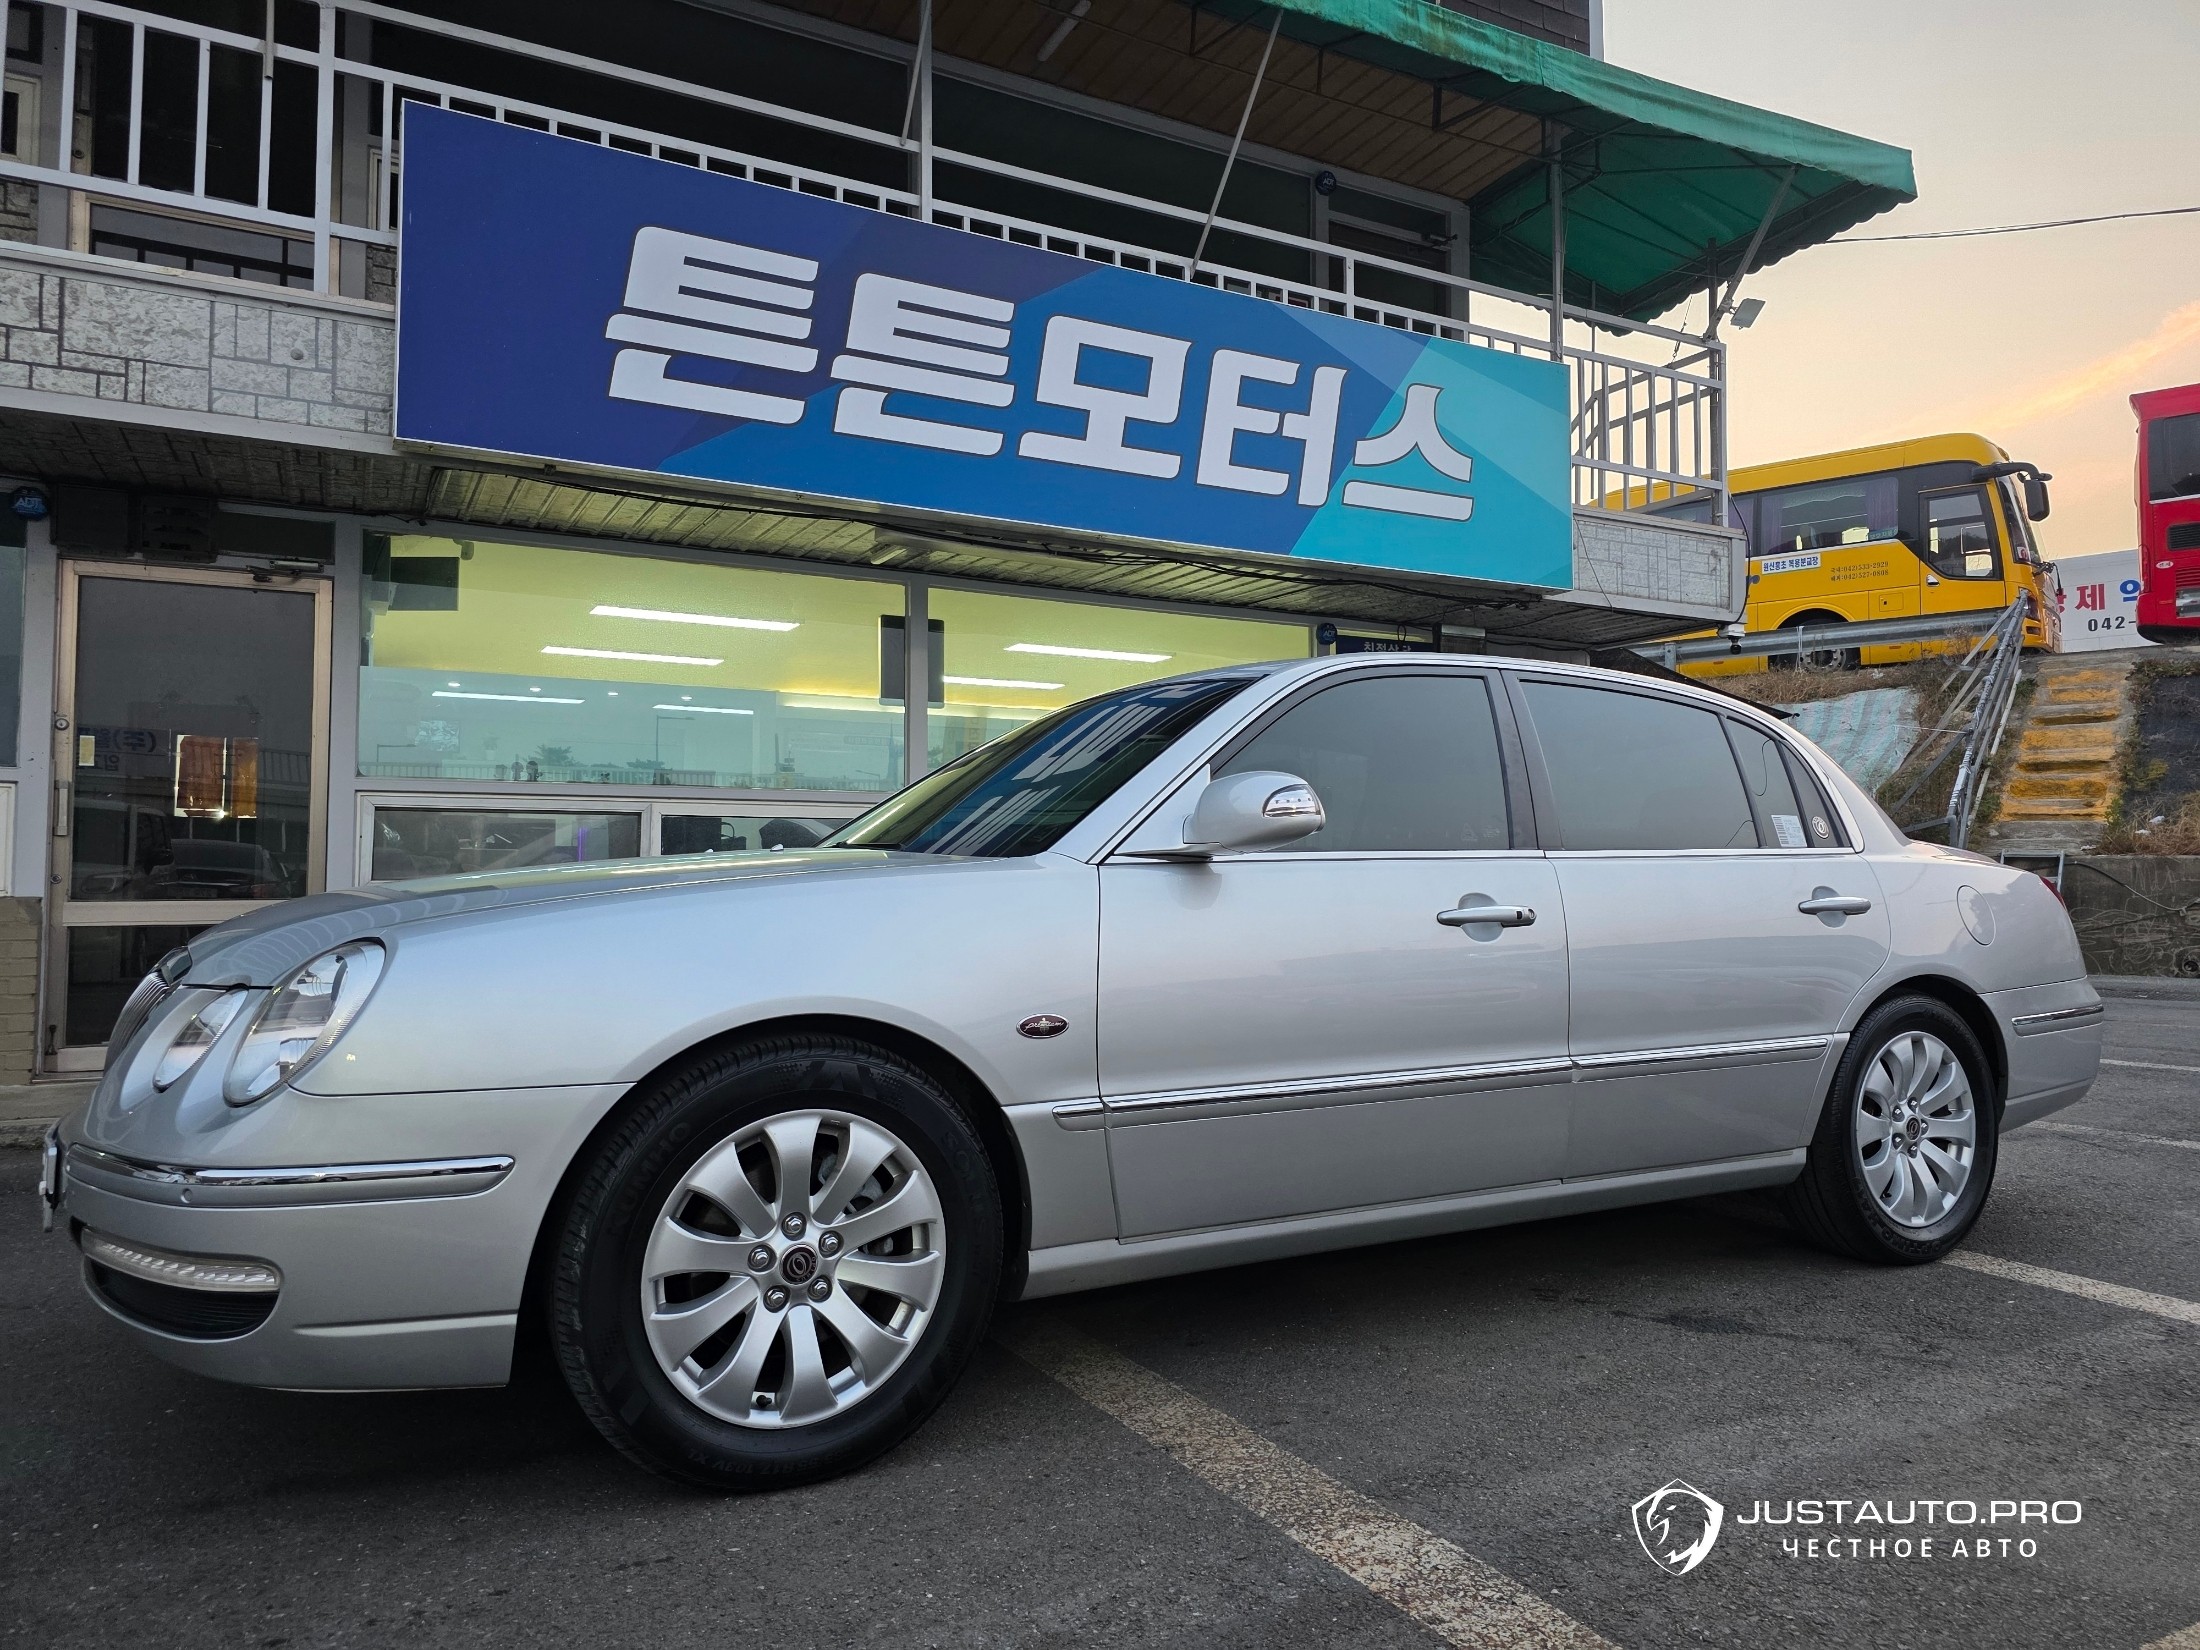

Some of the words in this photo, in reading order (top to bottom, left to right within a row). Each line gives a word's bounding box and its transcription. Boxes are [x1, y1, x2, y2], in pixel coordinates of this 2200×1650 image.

[604, 226, 1475, 522] 튼튼모터스
[1763, 560, 1787, 572] 원신흥초
[1788, 556, 1819, 568] 복용분교장
